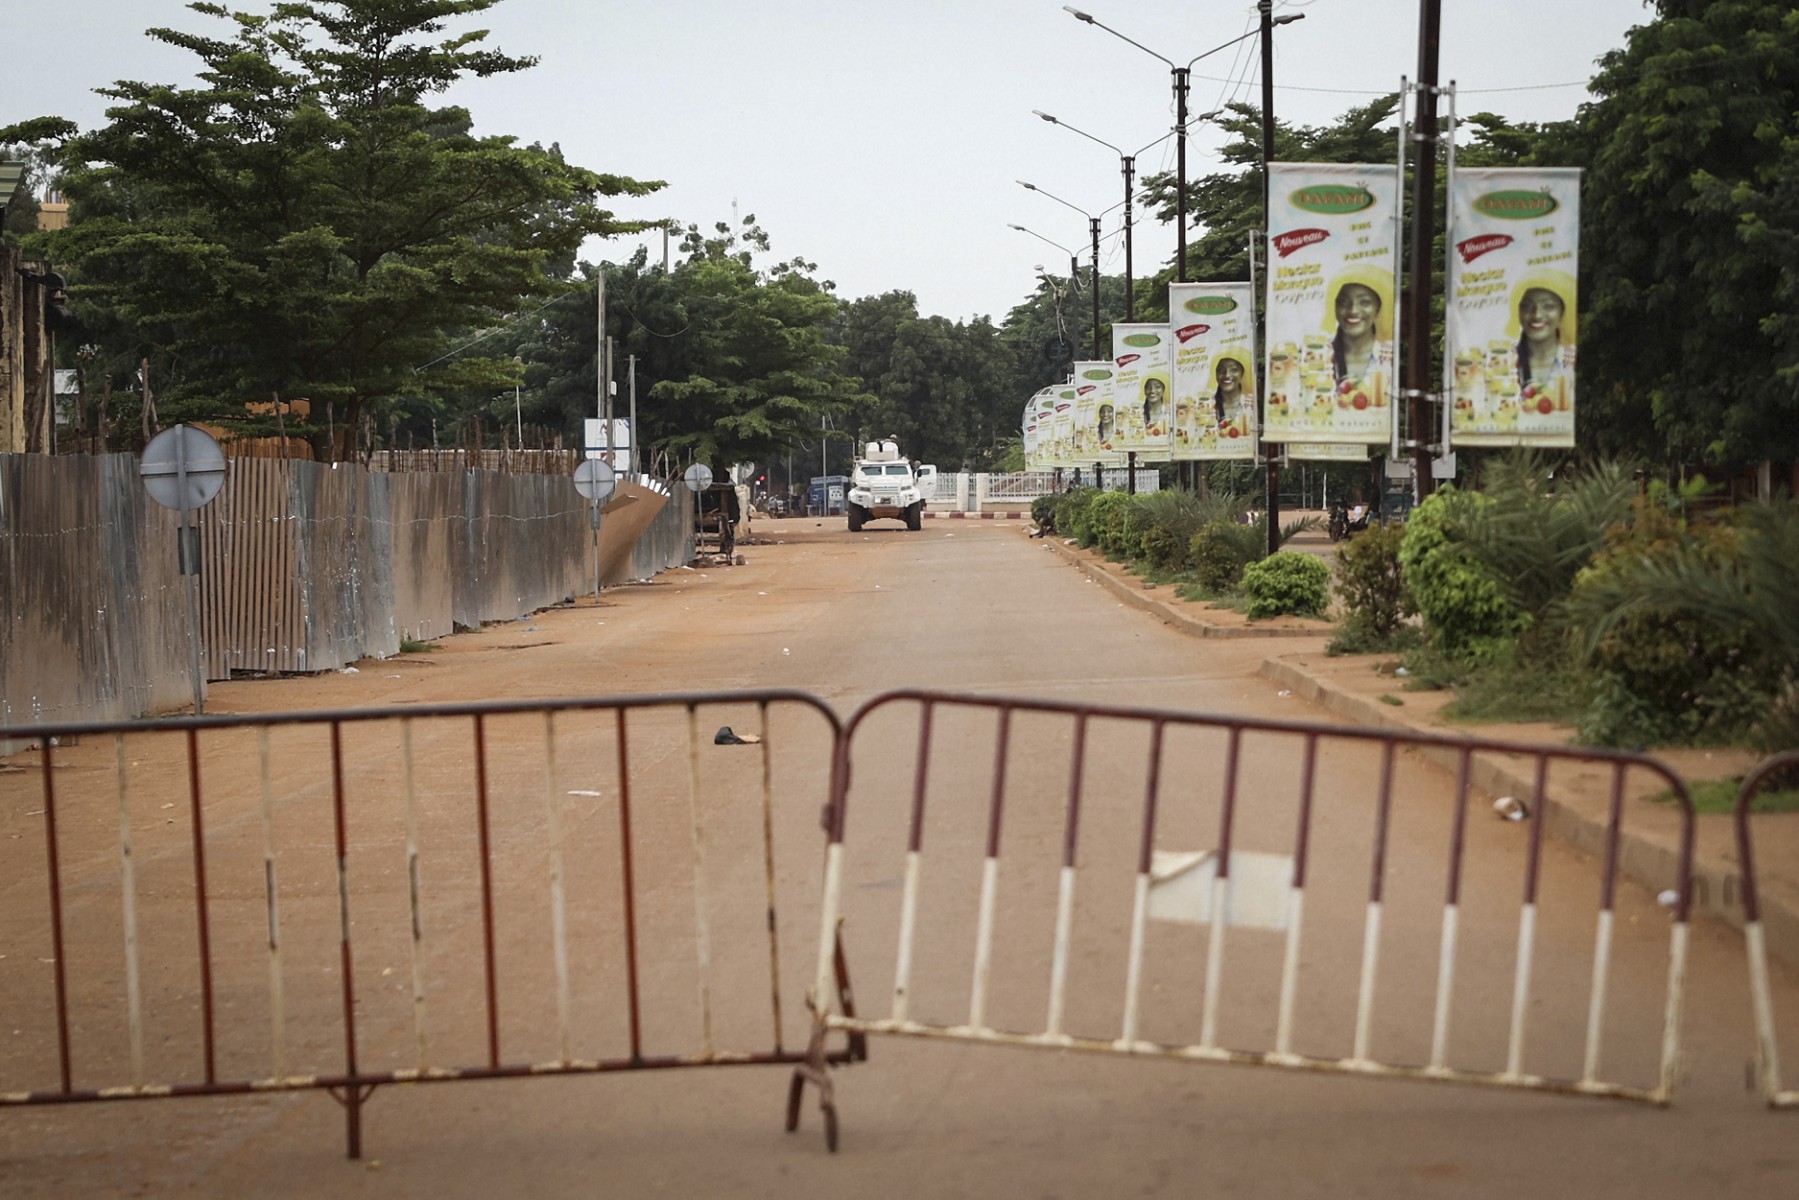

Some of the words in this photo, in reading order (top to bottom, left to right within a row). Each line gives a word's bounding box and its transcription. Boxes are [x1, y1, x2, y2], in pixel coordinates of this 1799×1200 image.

[1299, 191, 1364, 206] DAFANI
[1482, 197, 1549, 211] DAFANI
[1279, 232, 1323, 249] Nouveau
[1463, 237, 1507, 254] Nouveau
